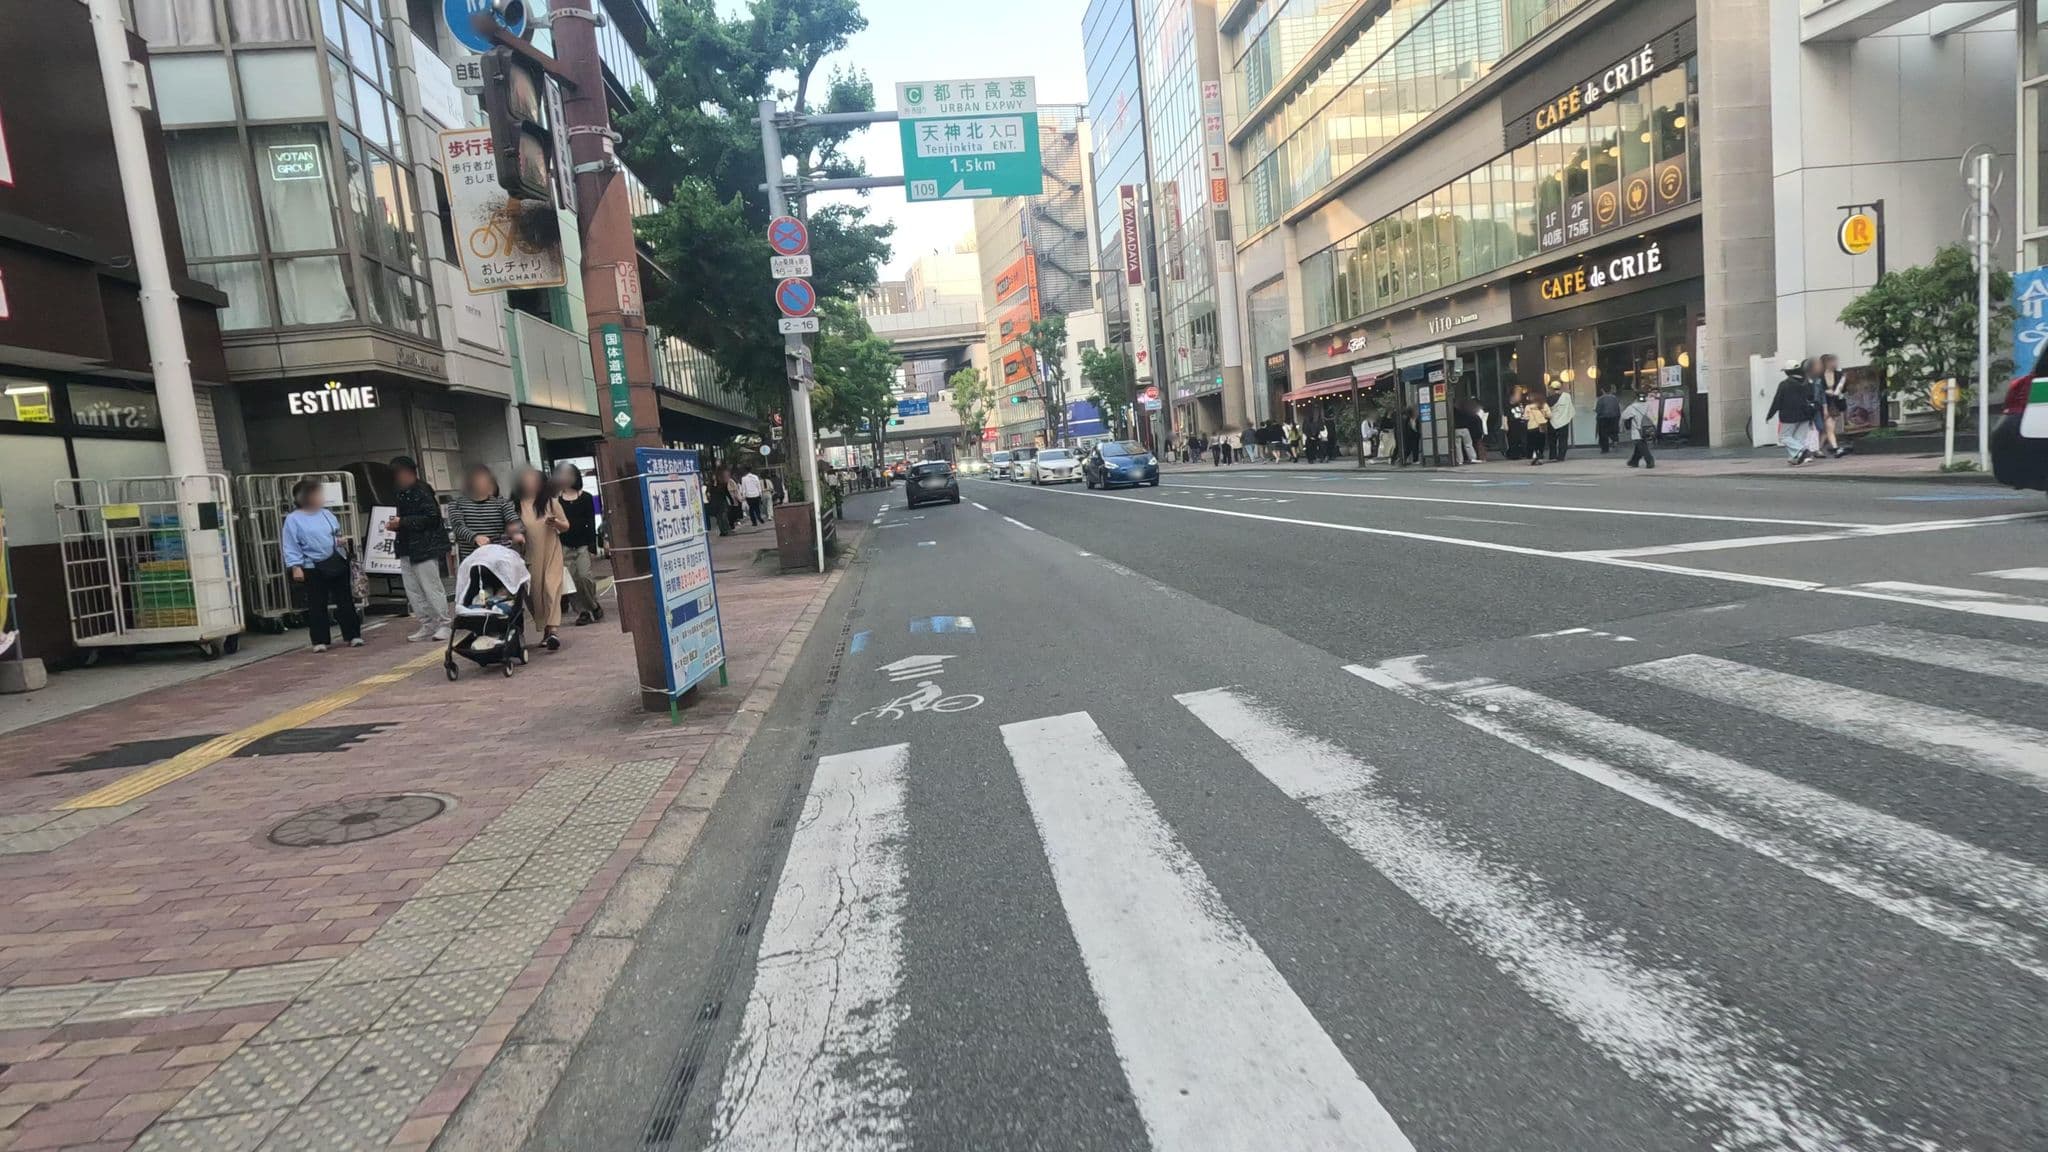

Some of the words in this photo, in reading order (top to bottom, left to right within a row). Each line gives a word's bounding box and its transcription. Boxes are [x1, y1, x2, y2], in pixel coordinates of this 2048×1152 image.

[934, 80, 1027, 101] 都市高速
[1535, 86, 1582, 130] CAFÉ
[1584, 82, 1600, 105] de
[1602, 44, 1656, 94] CRIÉ
[940, 102, 980, 113] URBAN
[985, 100, 1023, 111] EXPWY
[275, 152, 313, 161] VOTAN
[925, 142, 983, 155] Tenjinkita
[993, 140, 1017, 151] ENT.
[277, 163, 314, 173] GROUP
[950, 158, 996, 173] 1.5km
[914, 183, 936, 196] 109
[1571, 200, 1584, 218] 2F
[1545, 212, 1557, 229] 1F
[1567, 218, 1590, 238] 75席
[1849, 215, 1862, 234] R
[1124, 209, 1137, 272] YAMADAYA
[1542, 229, 1563, 247] 40席
[481, 260, 541, 276] おしチャリ
[1541, 267, 1586, 300] CAFÉ
[1590, 265, 1606, 287] de
[1609, 242, 1662, 281] CRIÉ
[621, 279, 637, 294] 15
[604, 333, 623, 385] 国体道路
[288, 384, 377, 415] ESTIME
[652, 488, 687, 513] 水道工事
